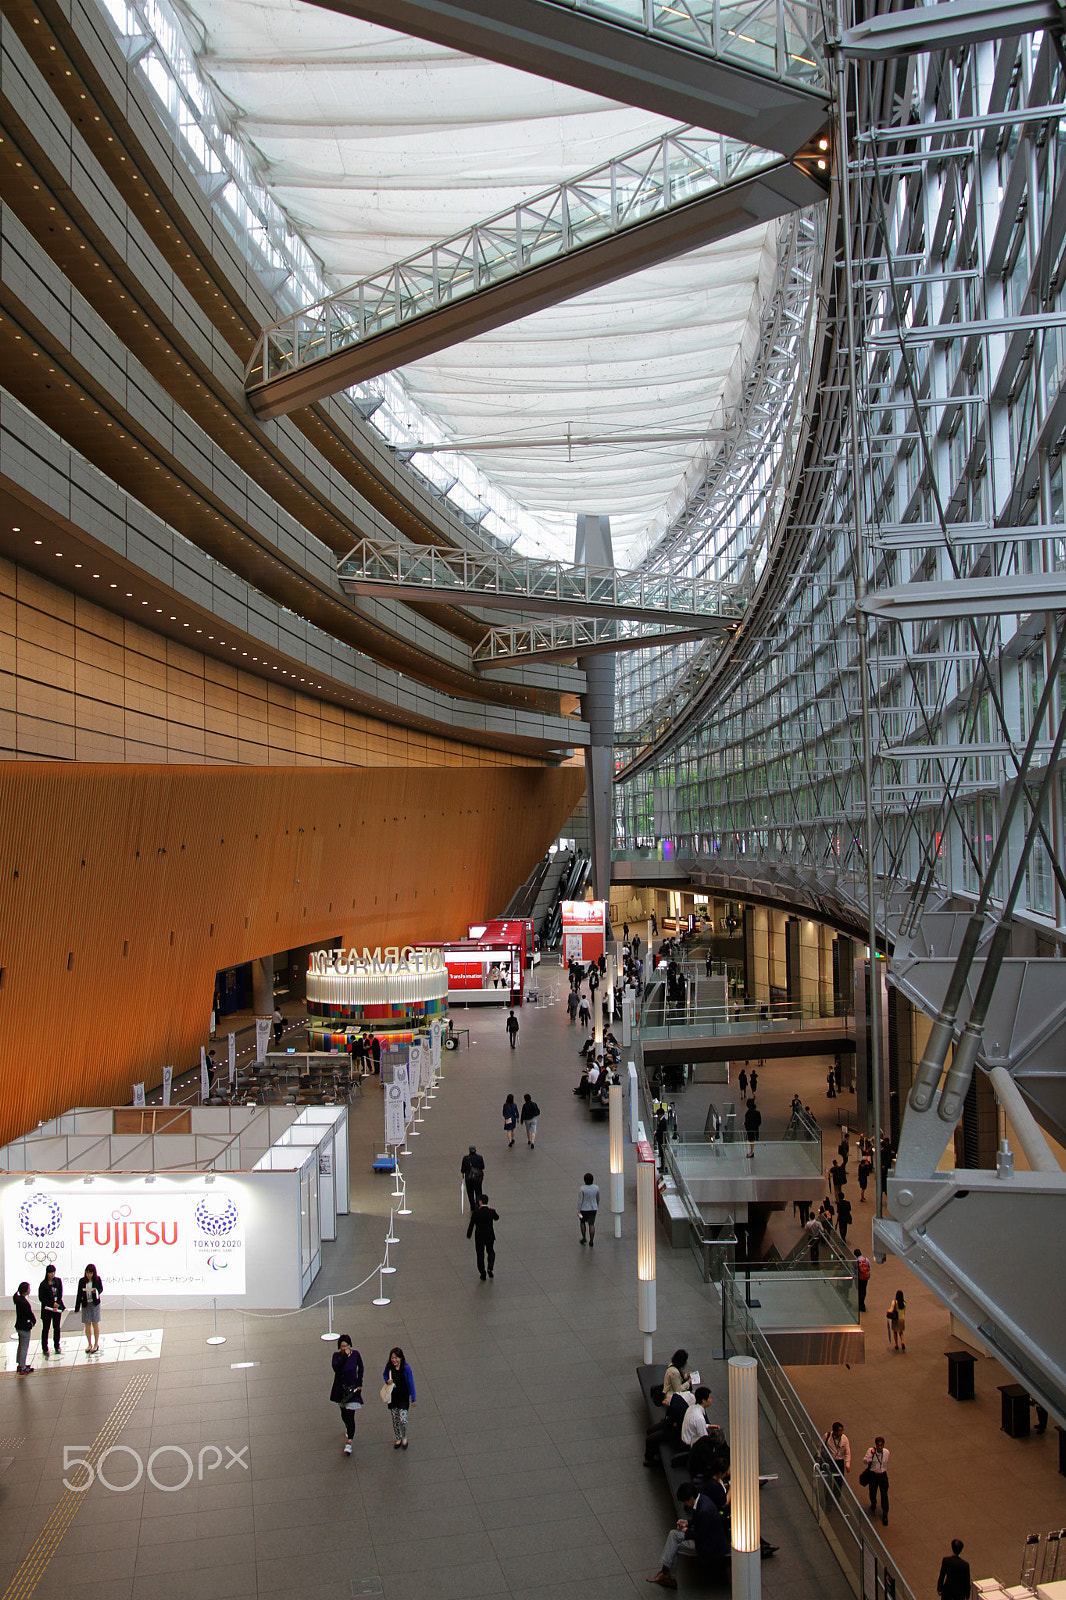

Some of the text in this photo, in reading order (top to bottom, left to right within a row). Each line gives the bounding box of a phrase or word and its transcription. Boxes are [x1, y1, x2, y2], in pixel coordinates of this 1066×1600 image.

[309, 950, 445, 975] INFORMATION
[17, 1240, 65, 1249] TOKYO 2020
[79, 1221, 178, 1254] FUJITSU
[193, 1239, 242, 1248] TOKYO 2020
